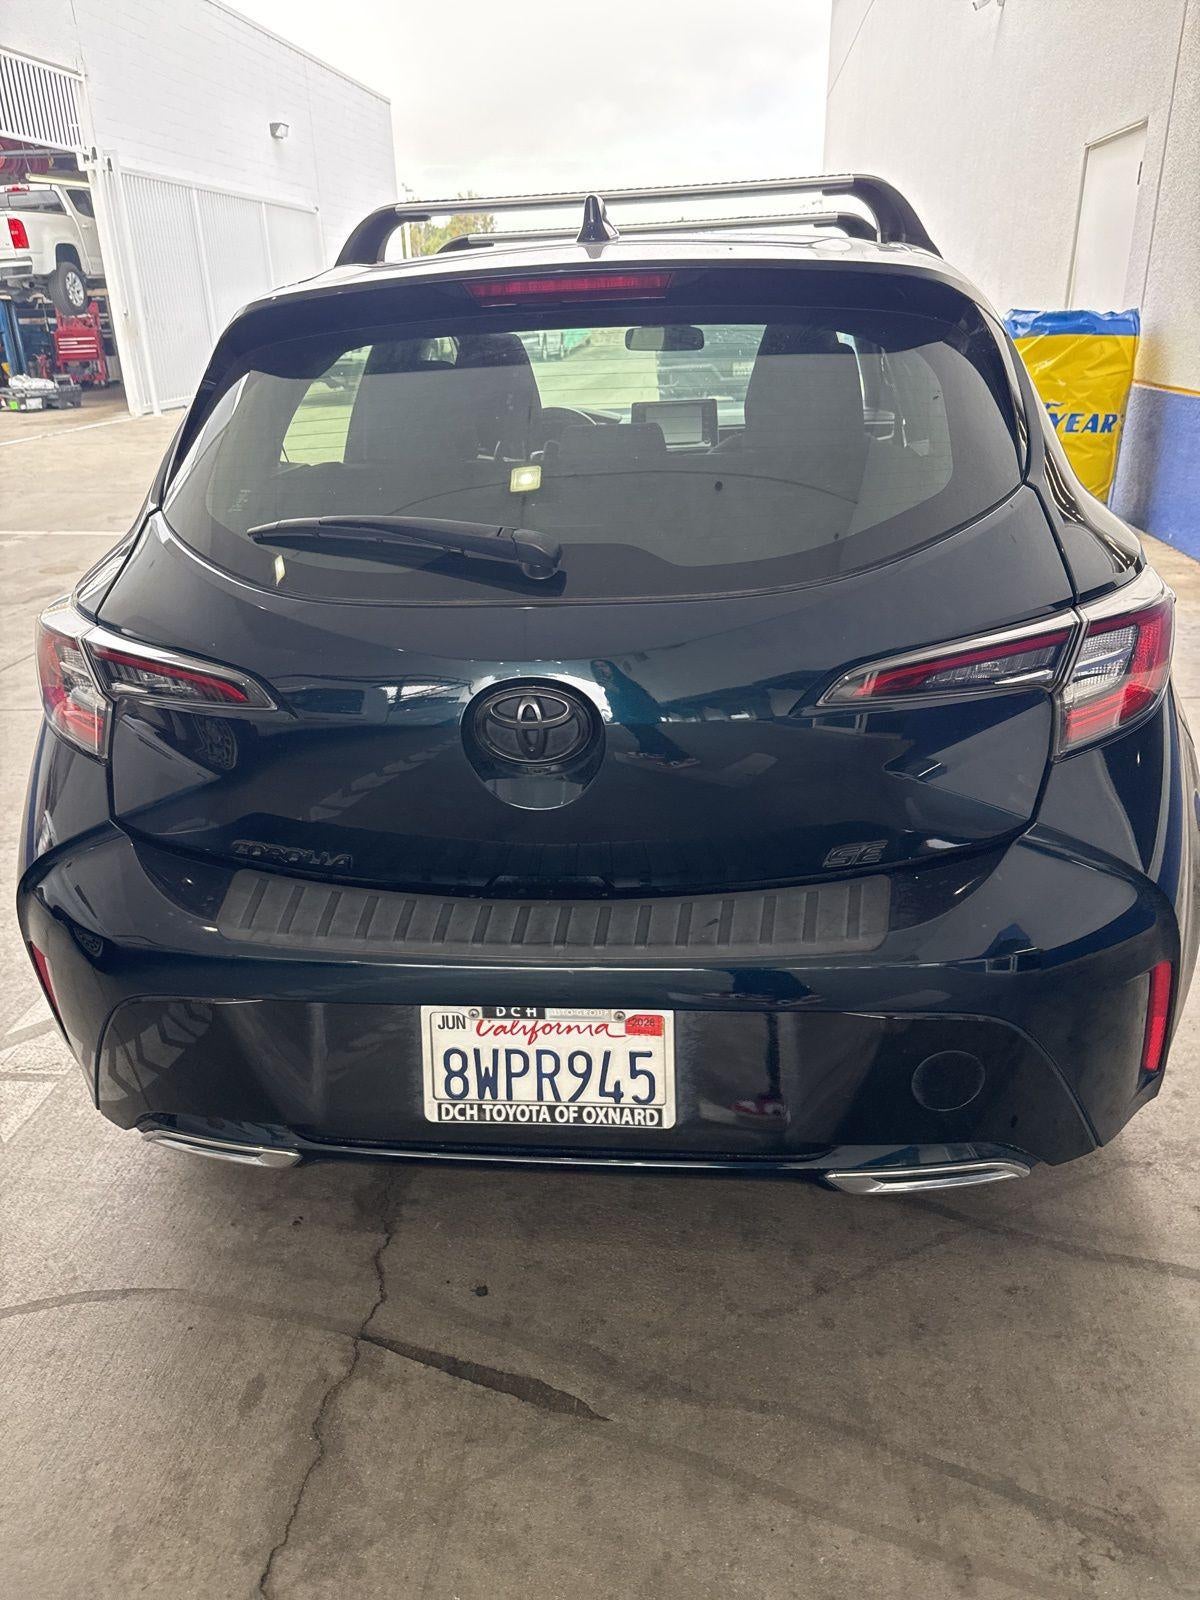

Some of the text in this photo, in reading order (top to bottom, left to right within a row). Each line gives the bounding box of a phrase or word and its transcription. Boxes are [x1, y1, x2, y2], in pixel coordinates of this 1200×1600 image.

[496, 1006, 537, 1017] DCH
[437, 1015, 466, 1030] JUN
[475, 1019, 626, 1045] California
[443, 1047, 656, 1105] 8WPR945
[441, 1105, 659, 1126] DCH TOYOTA OF OXNARD
